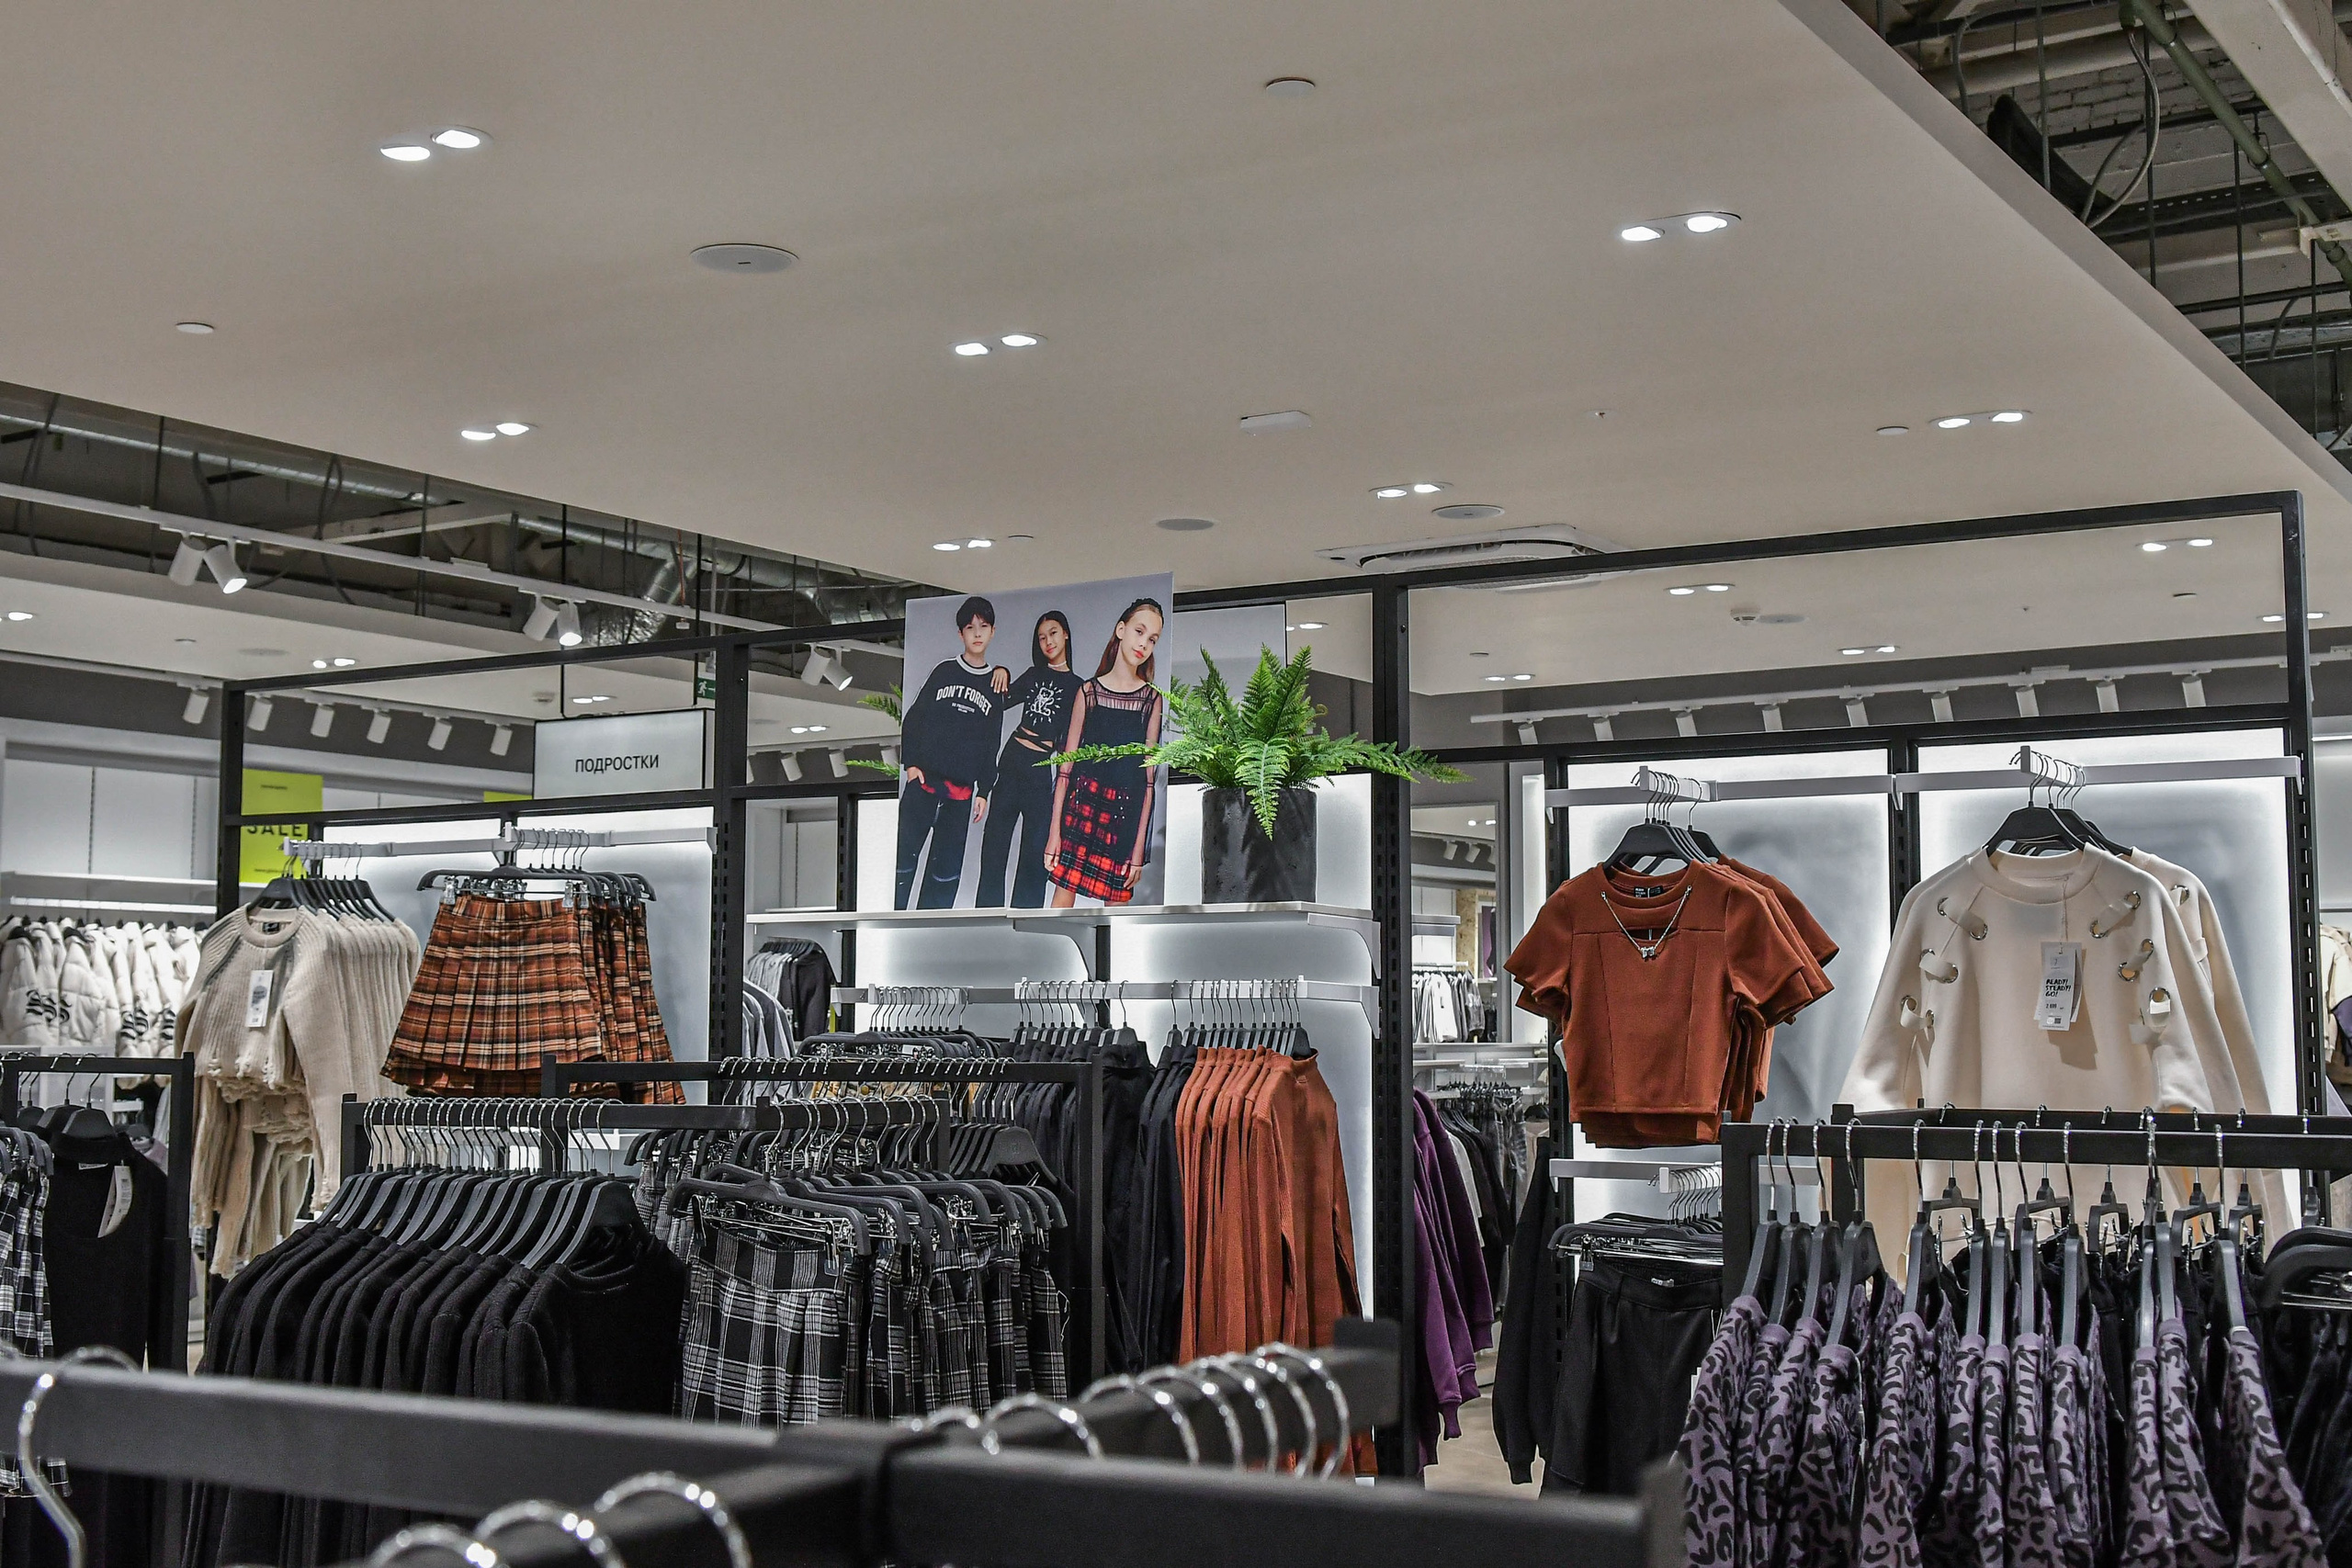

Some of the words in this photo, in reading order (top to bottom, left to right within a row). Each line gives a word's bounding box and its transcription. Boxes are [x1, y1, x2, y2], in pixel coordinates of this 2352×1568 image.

[935, 685, 965, 701] DON'T
[964, 686, 992, 716] FORGET
[575, 754, 659, 774] ПОДРОСТКИ
